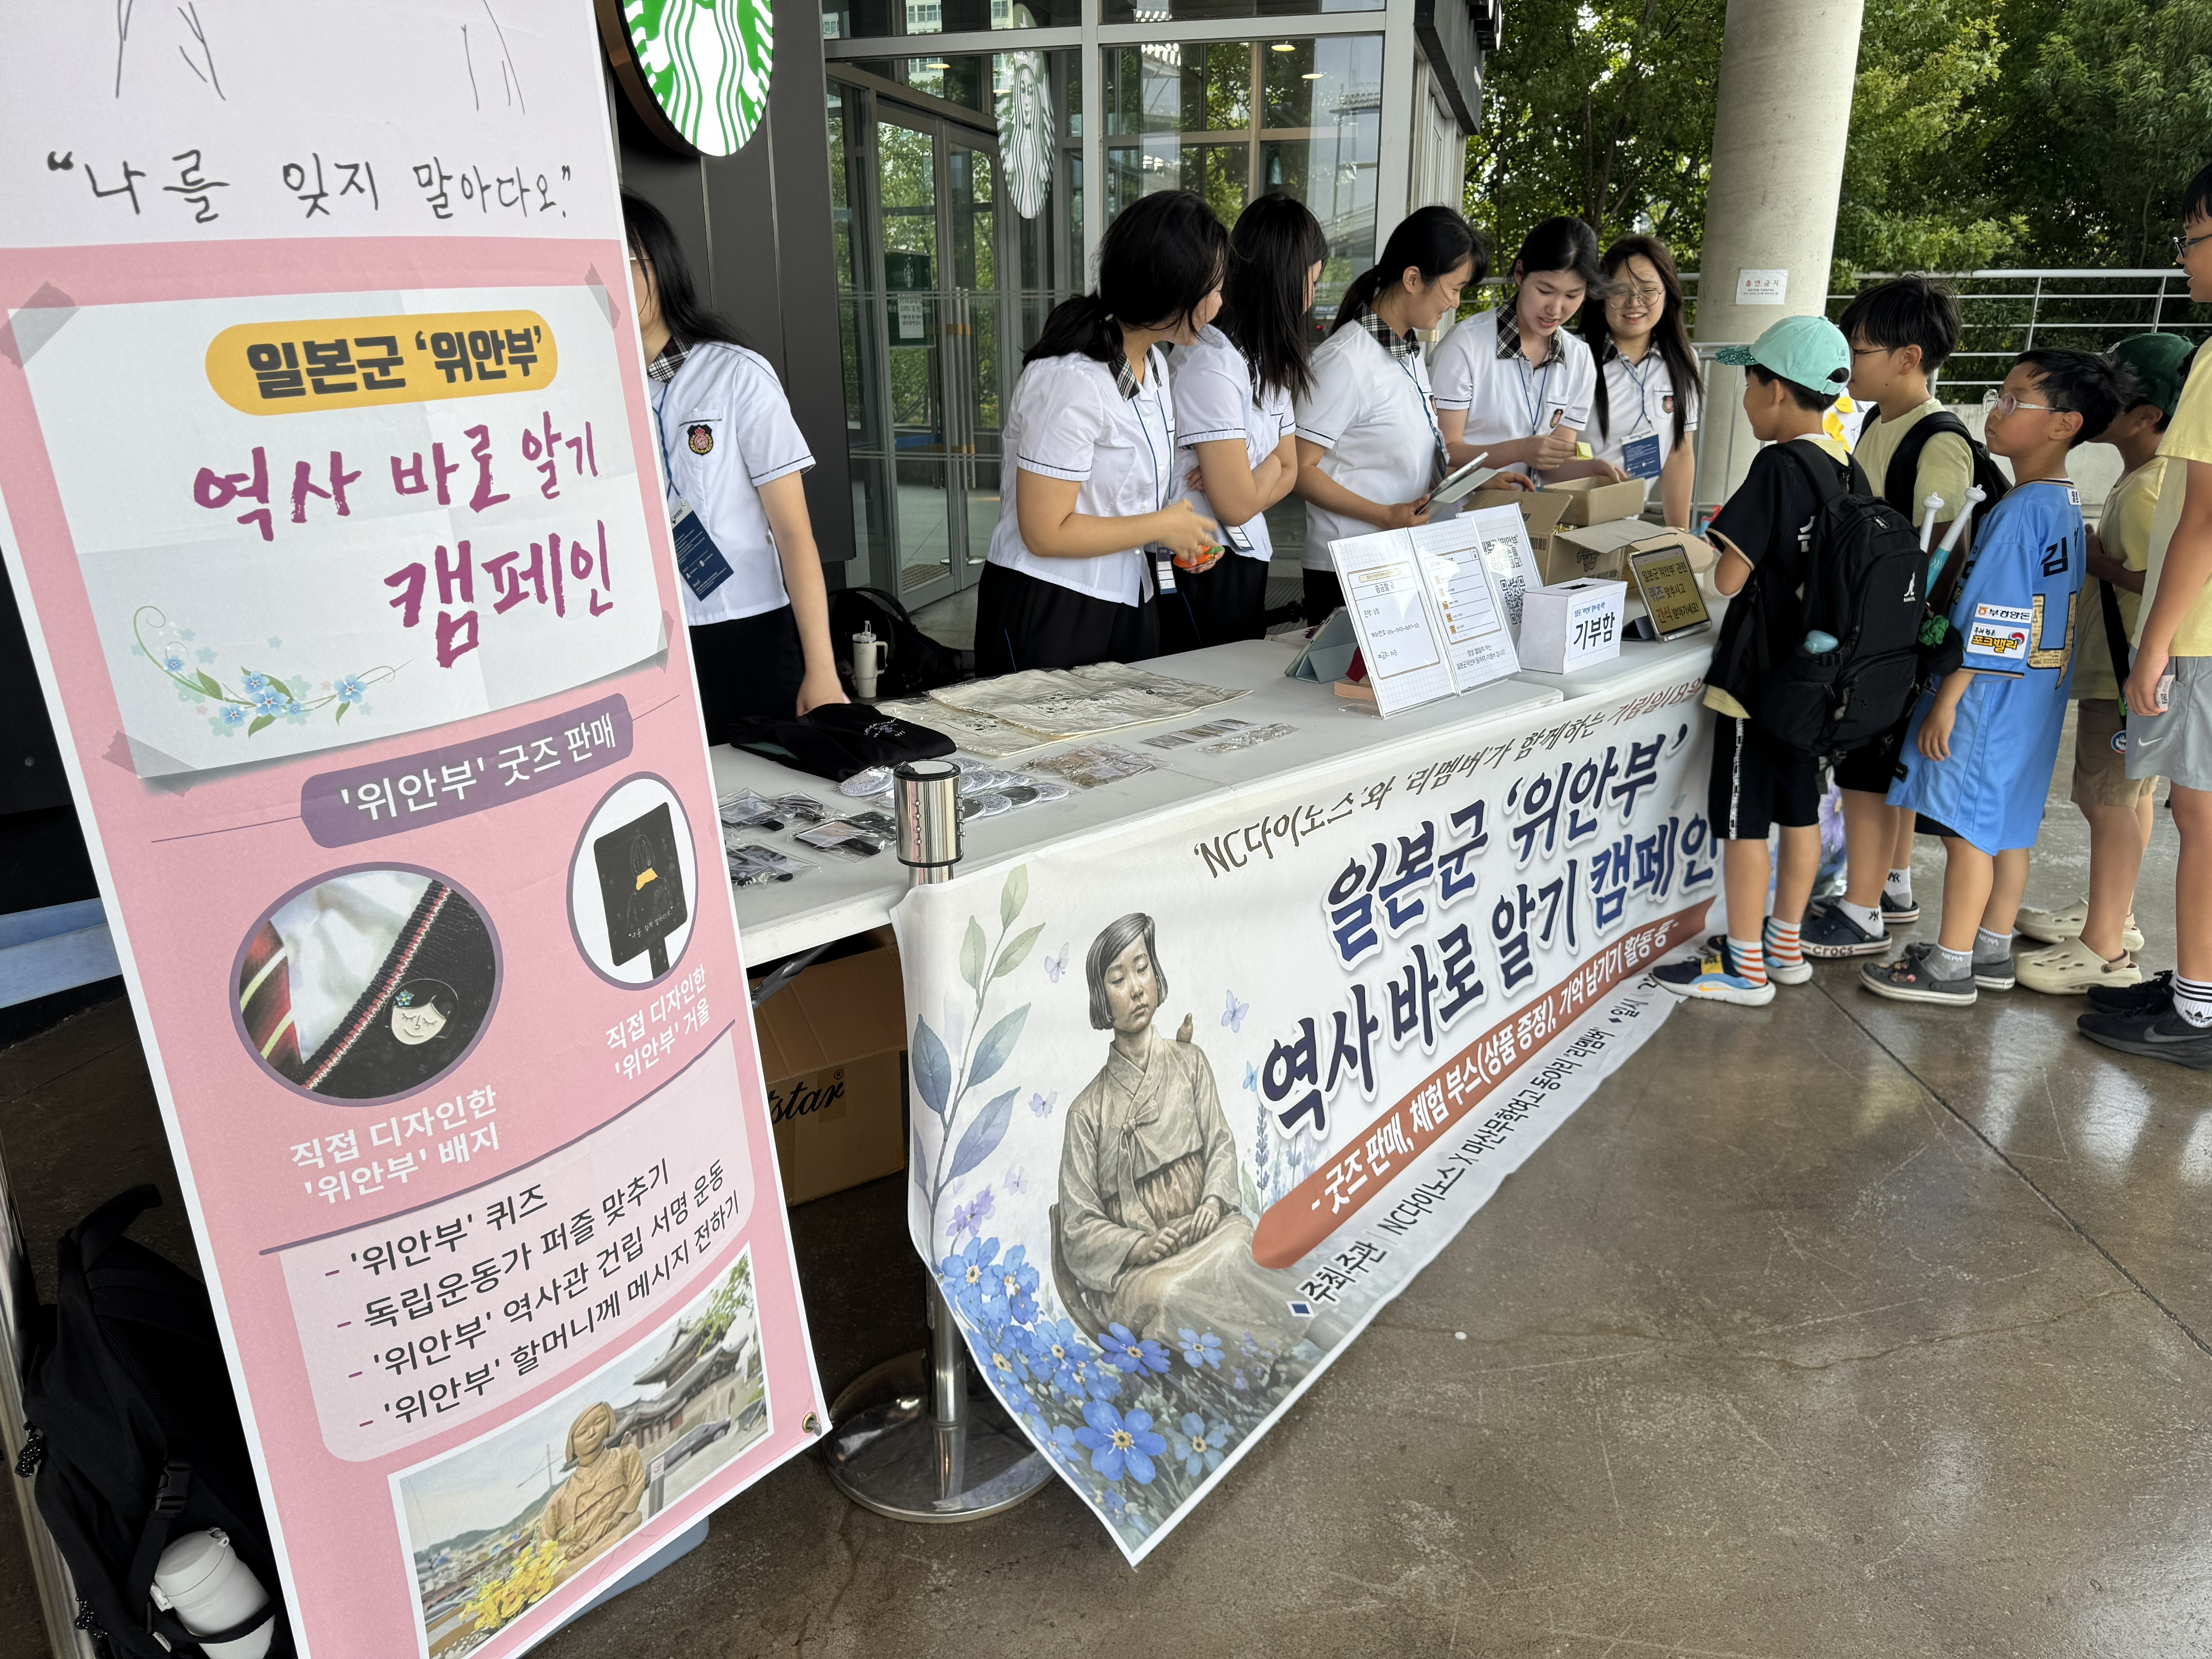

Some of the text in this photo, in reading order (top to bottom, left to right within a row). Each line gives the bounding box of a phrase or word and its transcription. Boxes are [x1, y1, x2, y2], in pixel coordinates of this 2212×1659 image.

[283, 153, 378, 218] 잊지
[246, 325, 542, 399] 일본군 ‘위안부’
[193, 410, 599, 542] 역사 바로 알기
[383, 519, 614, 669] 캠페인
[1573, 611, 1615, 650] 기부함
[1648, 583, 1686, 602] 퀴즈 맞추시고
[1656, 606, 1673, 623] 간식
[1989, 608, 2030, 620] 부경양돈
[1971, 634, 2018, 654] 포크밸리
[341, 712, 616, 821] '위안부' 굿즈 판매
[1520, 711, 1605, 759] 함께하는
[1328, 723, 1689, 962] 일본군 ‘위안부’
[1262, 812, 1717, 1132] 역사 바로 알기 캠페인
[1812, 944, 1854, 957] crocs
[605, 963, 707, 1050] 직접 디자인한
[614, 1000, 710, 1080] '위안부' 거울
[1365, 1112, 1414, 1176] 판매,
[1409, 1083, 1449, 1133] 체험
[1559, 970, 1584, 1015] 기억
[1586, 942, 1623, 997] 남기기
[1624, 927, 1656, 968] 활동
[290, 1084, 497, 1167] 직접 디자인한
[304, 1121, 500, 1204] '위안부' 배지
[1376, 1167, 1466, 1235] NC다이노스
[1461, 1089, 1546, 1154] 마산무학여고
[1530, 1058, 1583, 1091] 동아리
[350, 1183, 548, 1273] '위안부' 퀴즈
[364, 1158, 668, 1327] 독립운동가 퍼즐 맞추기
[373, 1158, 723, 1373] '위안부' 역사관 건립 서명 운동
[384, 1189, 738, 1423] '위안부' 할머니께 메시지 전하기
